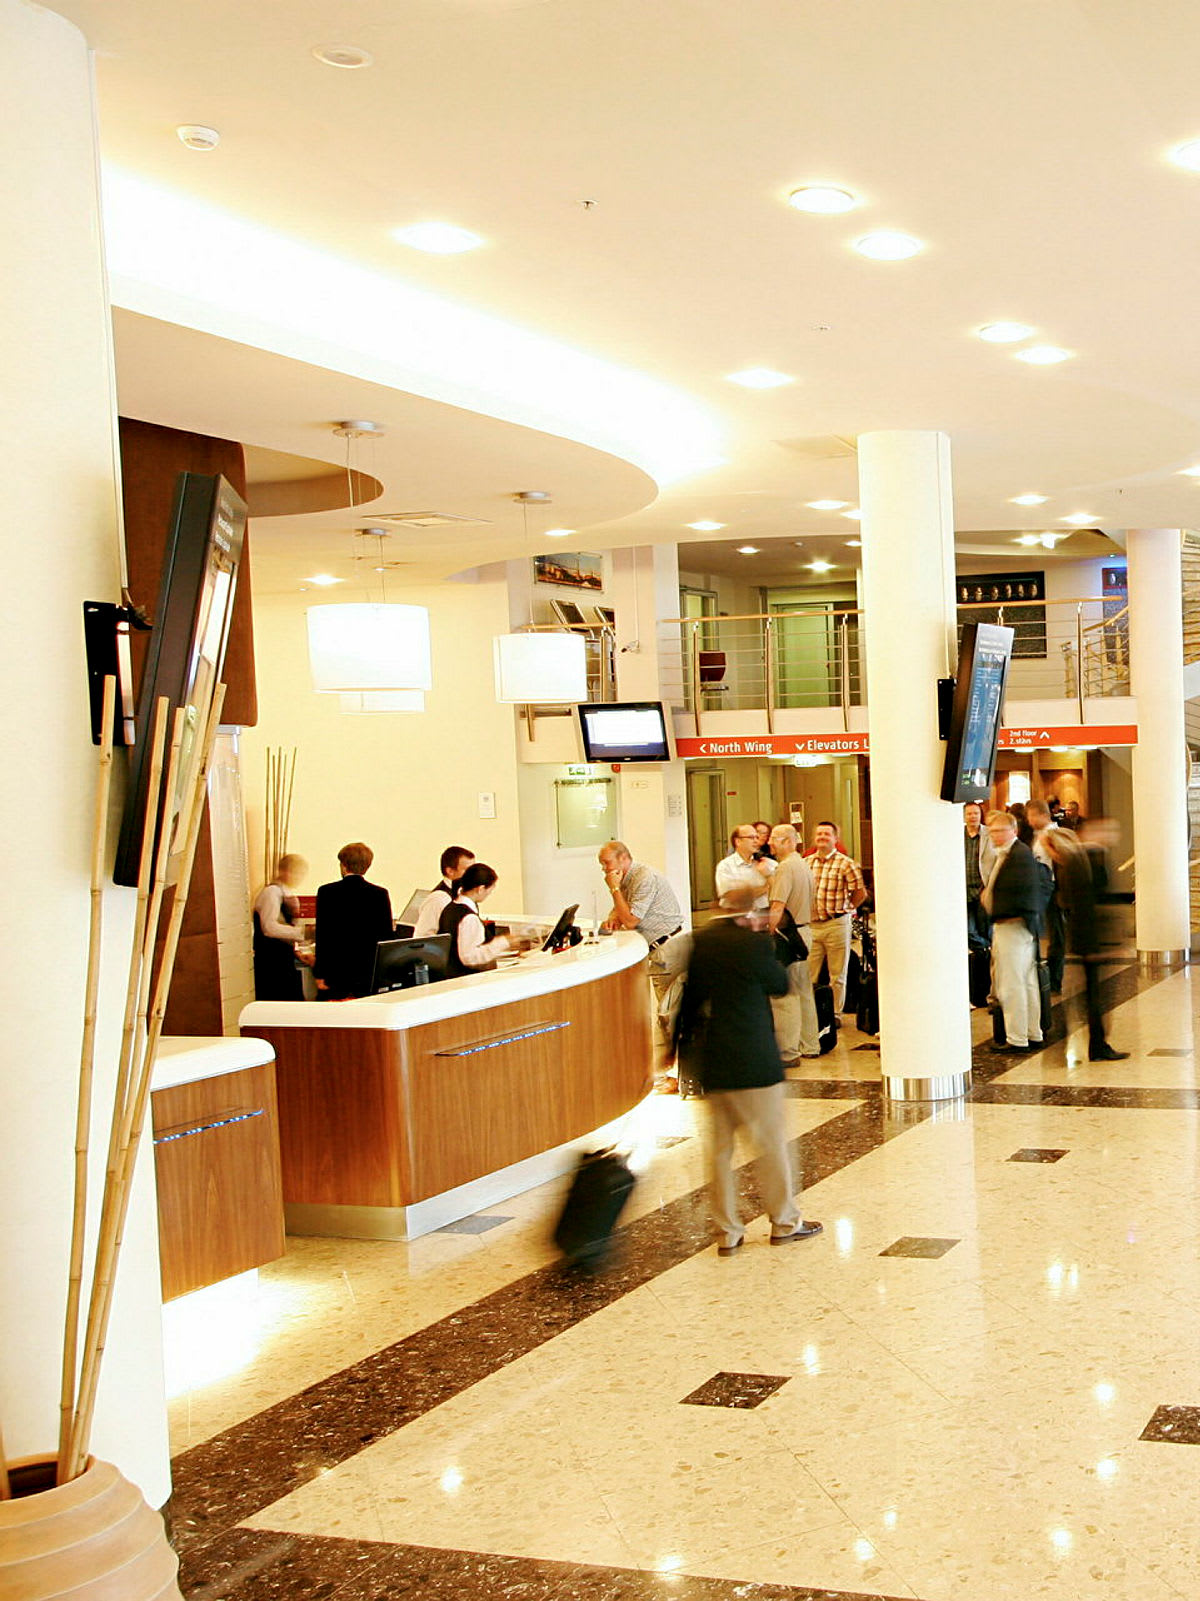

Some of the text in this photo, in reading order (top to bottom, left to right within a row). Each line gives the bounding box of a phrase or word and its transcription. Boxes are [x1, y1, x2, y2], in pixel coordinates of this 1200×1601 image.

[709, 741, 772, 754] North Wing
[807, 739, 859, 750] Elevators
